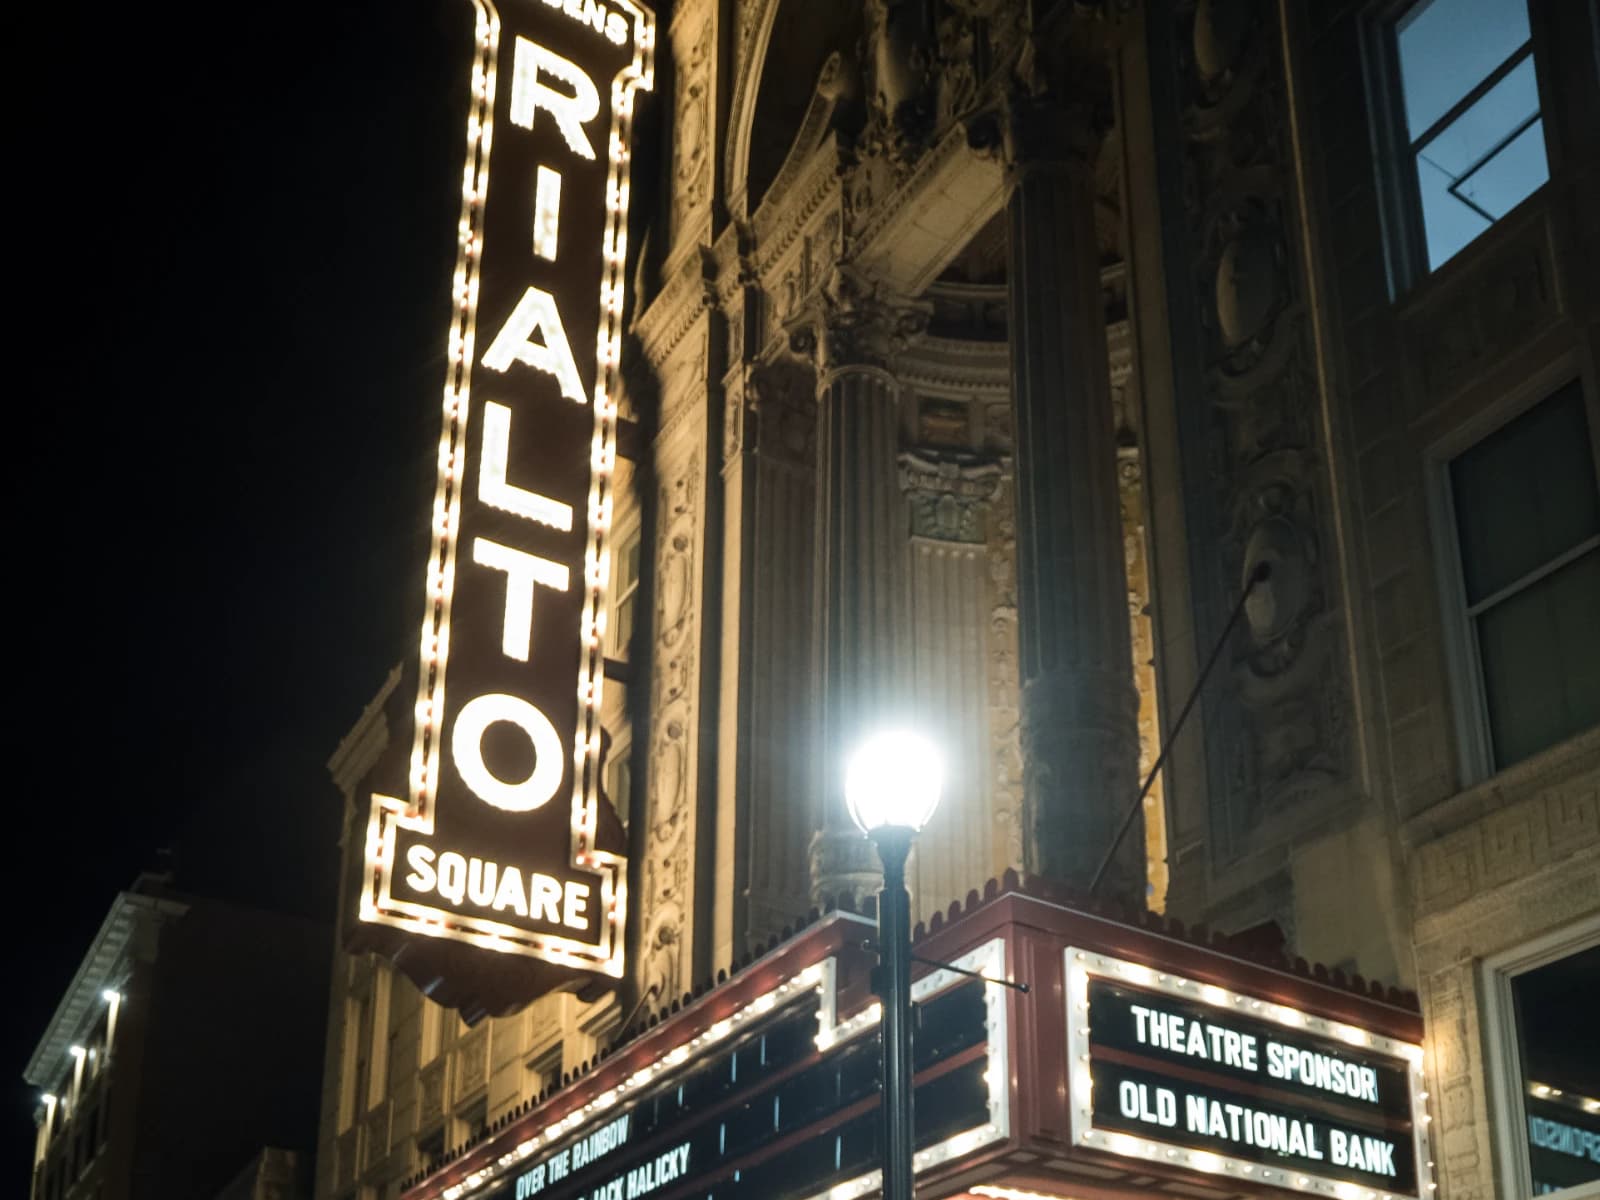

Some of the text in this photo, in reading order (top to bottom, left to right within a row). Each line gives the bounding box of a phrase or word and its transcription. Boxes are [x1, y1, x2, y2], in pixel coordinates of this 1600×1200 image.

[451, 35, 601, 812] RIALTO
[406, 844, 590, 930] SQUARE
[1130, 1004, 1379, 1103] THEATRE SPONSOR
[548, 1149, 570, 1184] THE
[572, 1114, 630, 1171] RAINBOW
[626, 1142, 691, 1200] HALICKY
[1118, 1080, 1396, 1178] OLD NATIONAL BANK
